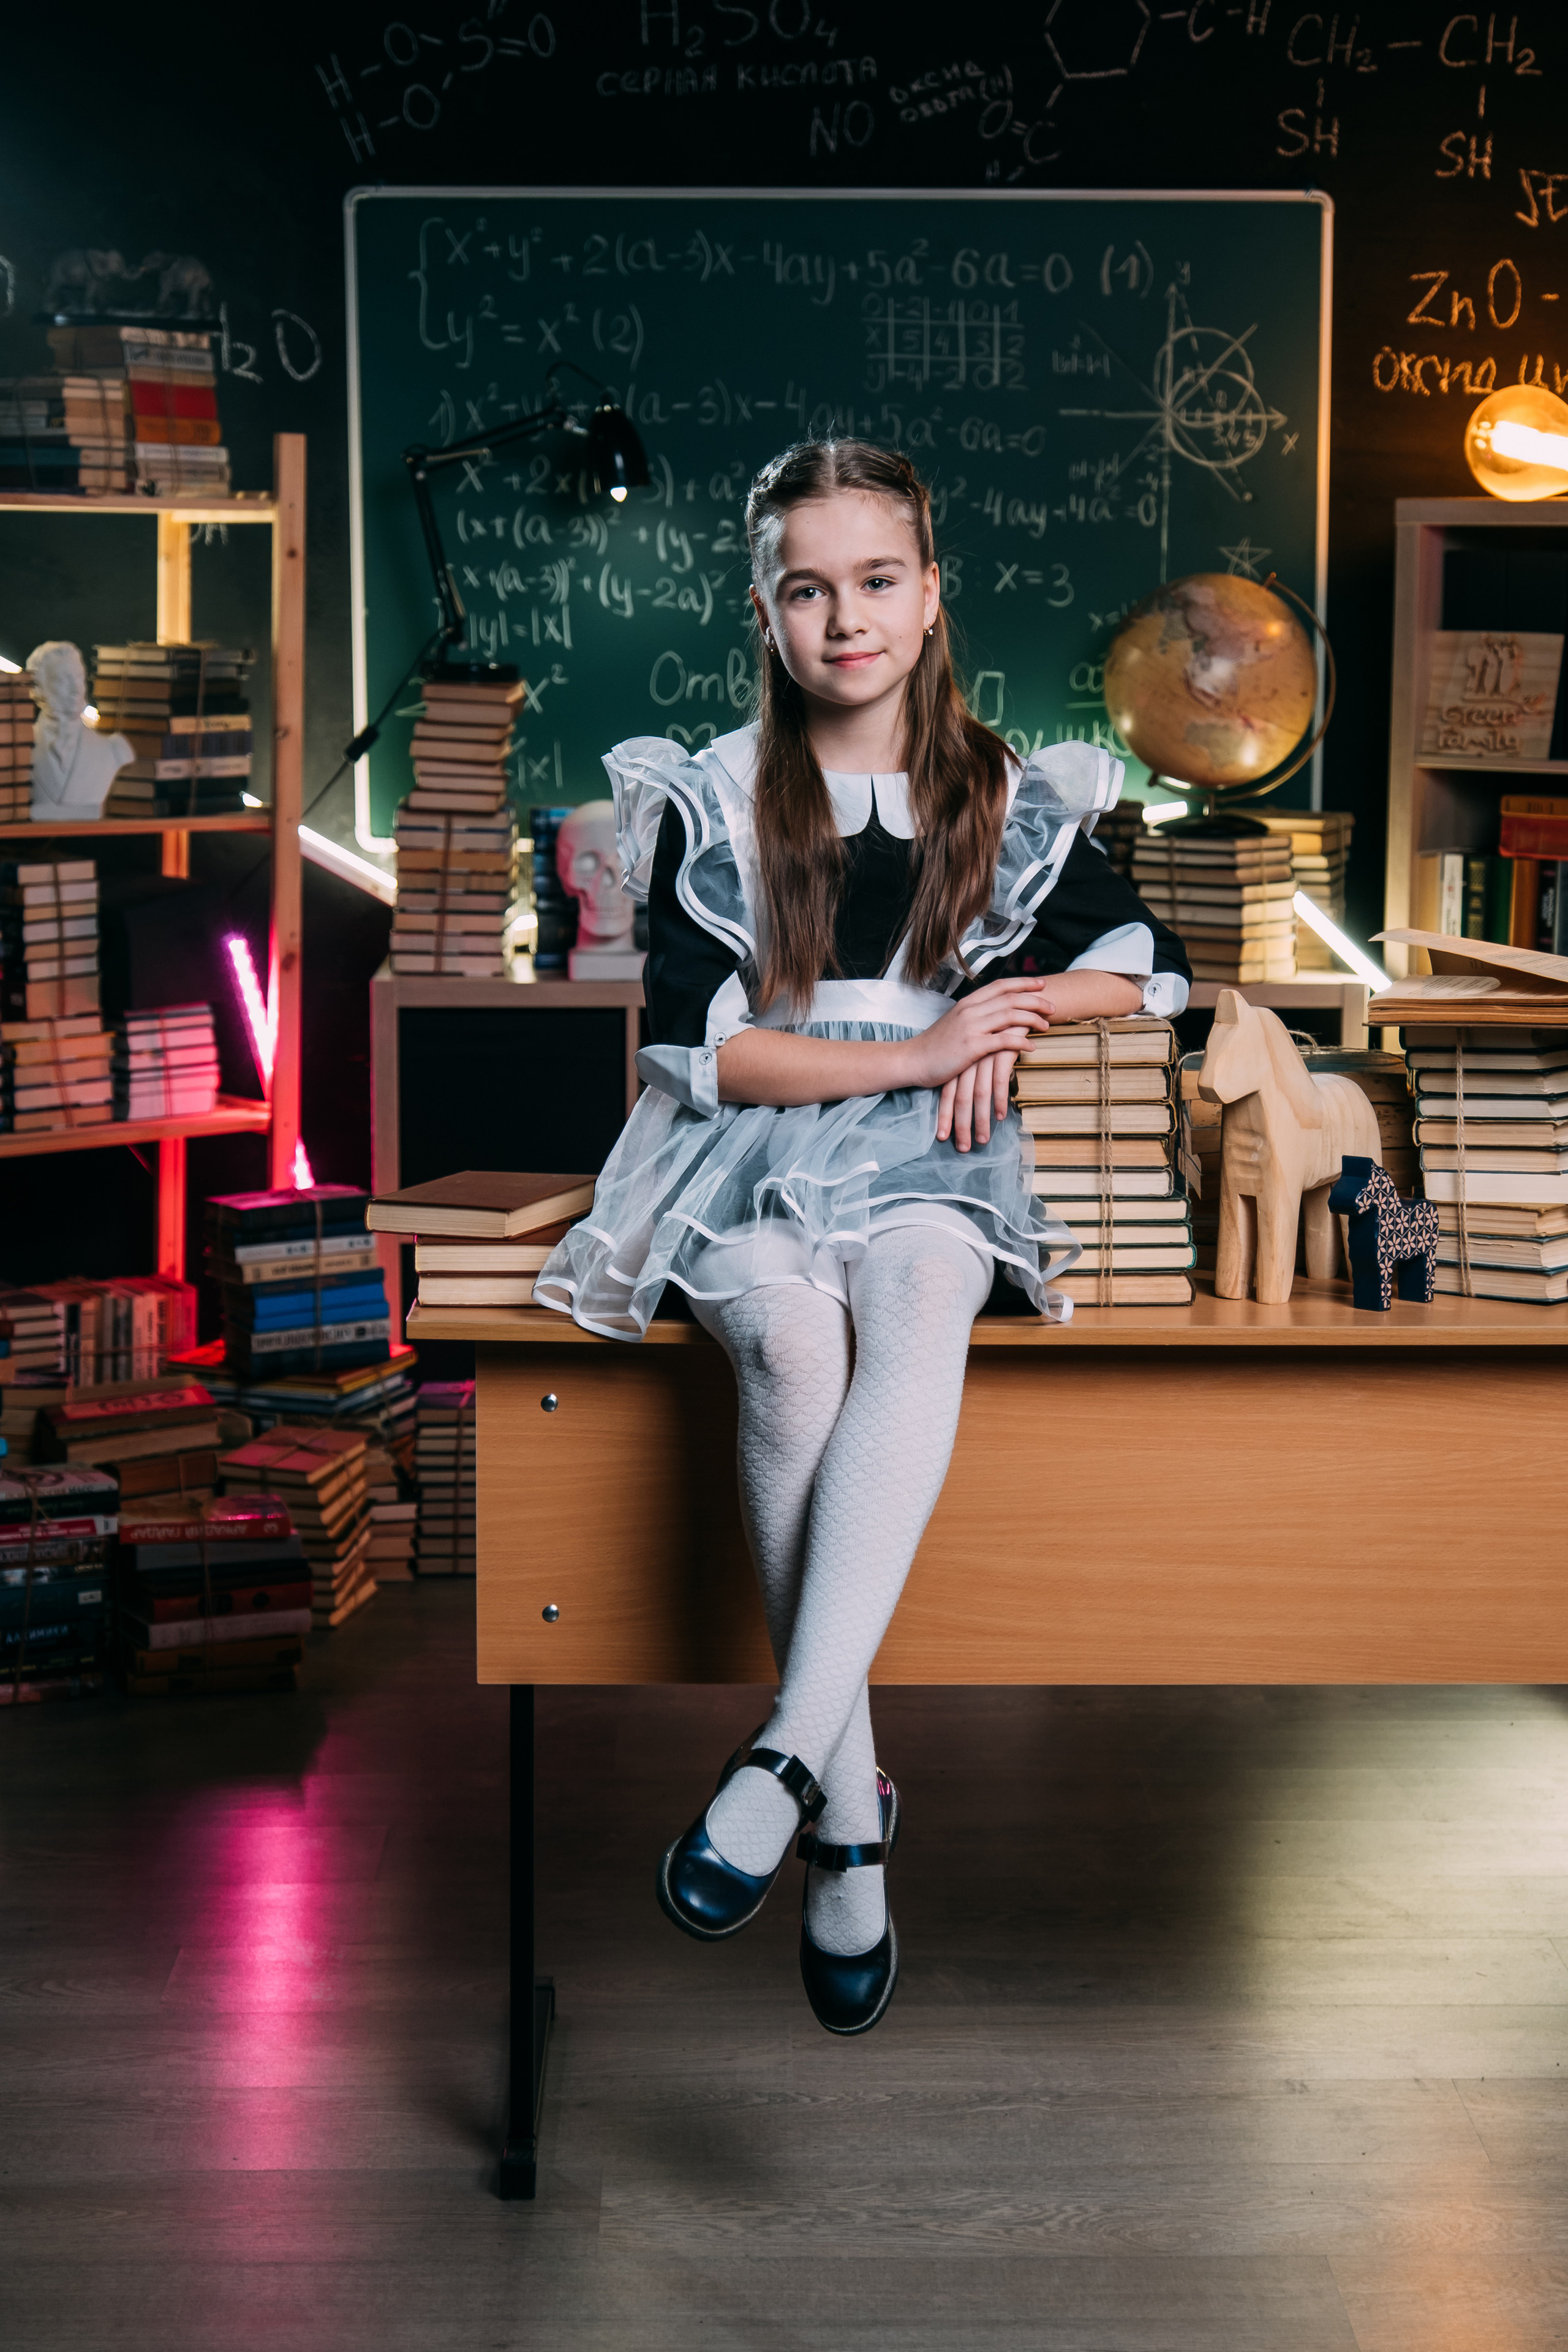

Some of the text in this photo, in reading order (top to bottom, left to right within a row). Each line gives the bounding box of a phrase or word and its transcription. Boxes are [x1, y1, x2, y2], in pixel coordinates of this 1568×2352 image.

[809, 99, 875, 158] NO
[1276, 108, 1340, 160] SH
[1434, 130, 1494, 181] SH
[1407, 258, 1523, 331] ZnO
